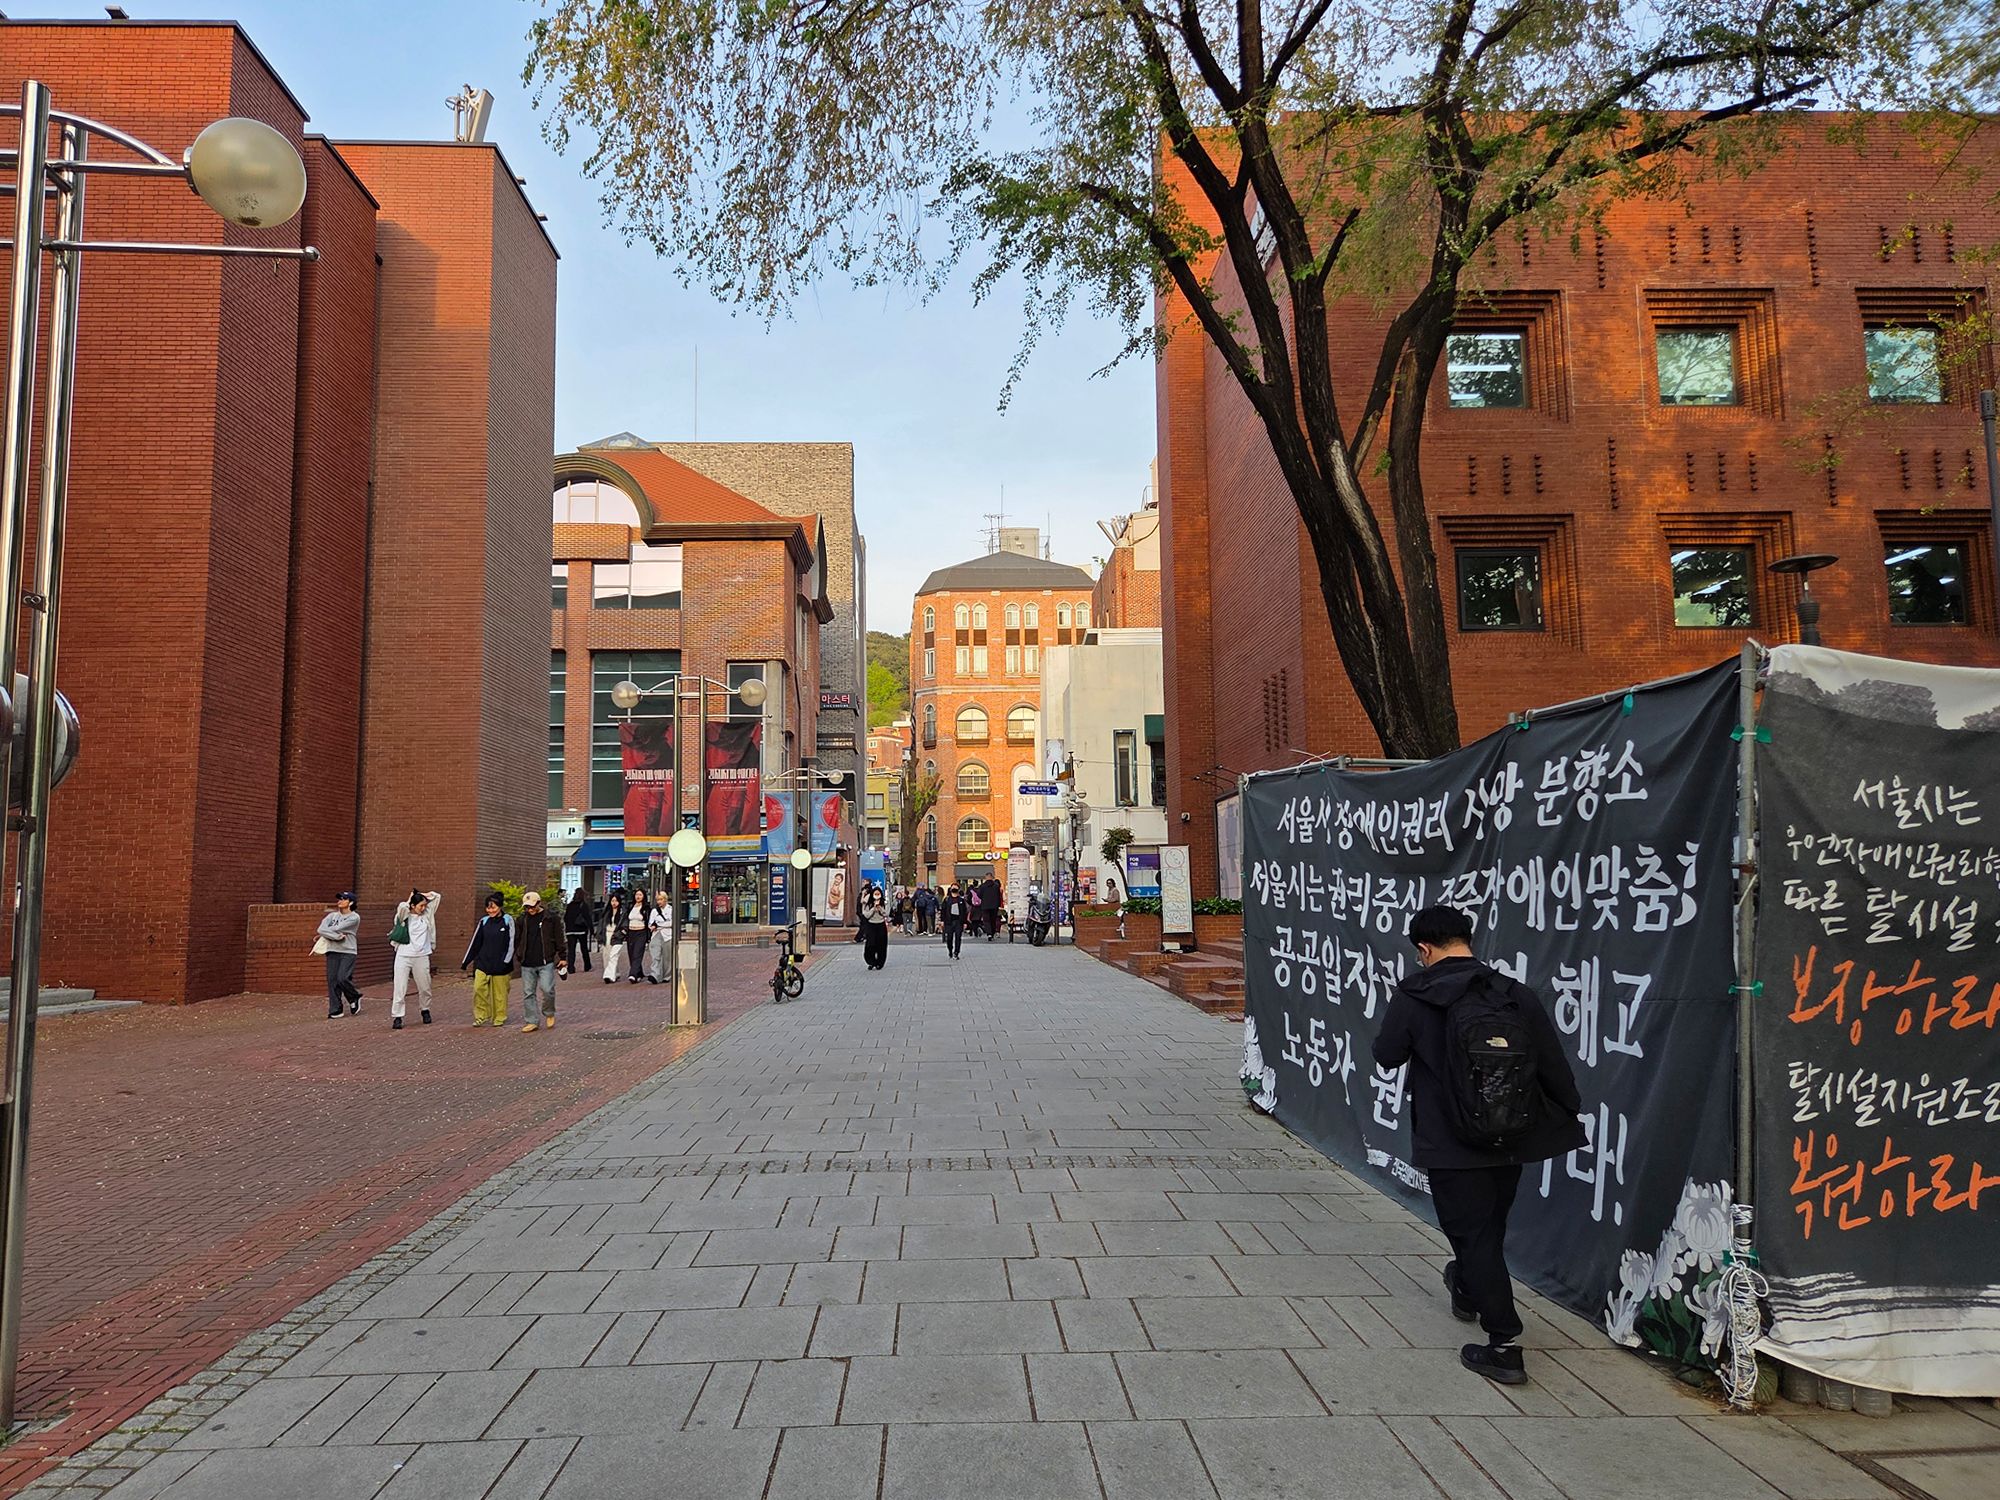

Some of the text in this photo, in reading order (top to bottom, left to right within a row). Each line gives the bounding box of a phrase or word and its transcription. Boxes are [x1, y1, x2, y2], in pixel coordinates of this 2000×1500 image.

[1277, 790, 1332, 844] 서울시
[1534, 739, 1649, 827] 분향소
[1853, 775, 1981, 829] 서울시는
[984, 852, 1001, 860] CU
[1250, 859, 1325, 913] 서울시는
[1328, 867, 1426, 937] 권리중심
[1864, 887, 1979, 953] 탈시설
[1269, 925, 1652, 1068] 공공일자리 해고
[1788, 944, 2000, 1046] 보장하라
[1281, 1011, 1357, 1106] 노동자
[1789, 1129, 2000, 1240] 복원하라
